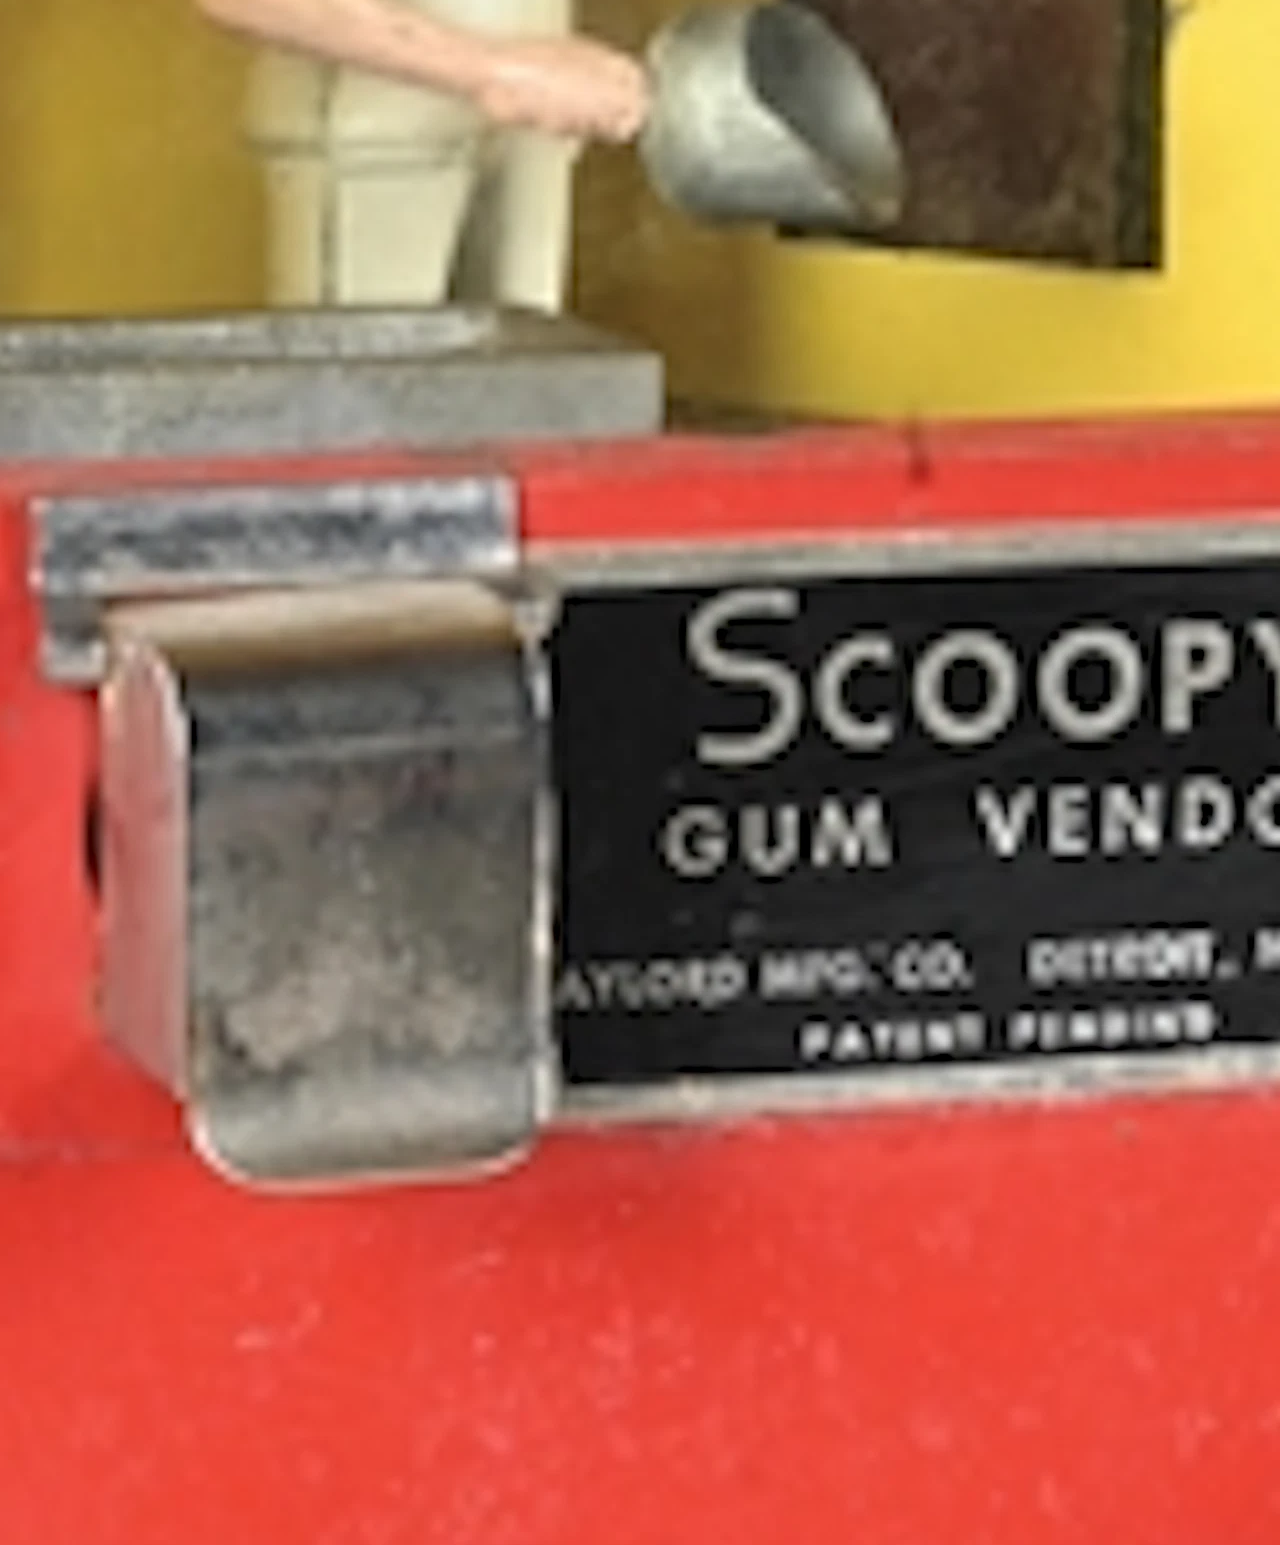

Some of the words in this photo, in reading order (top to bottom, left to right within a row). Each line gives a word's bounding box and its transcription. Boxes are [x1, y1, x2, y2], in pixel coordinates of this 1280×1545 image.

[662, 794, 894, 876] GUM
[558, 954, 748, 1010] AYLORD
[800, 1012, 986, 1062] PATENT
[1006, 1002, 1216, 1050] PENDING
